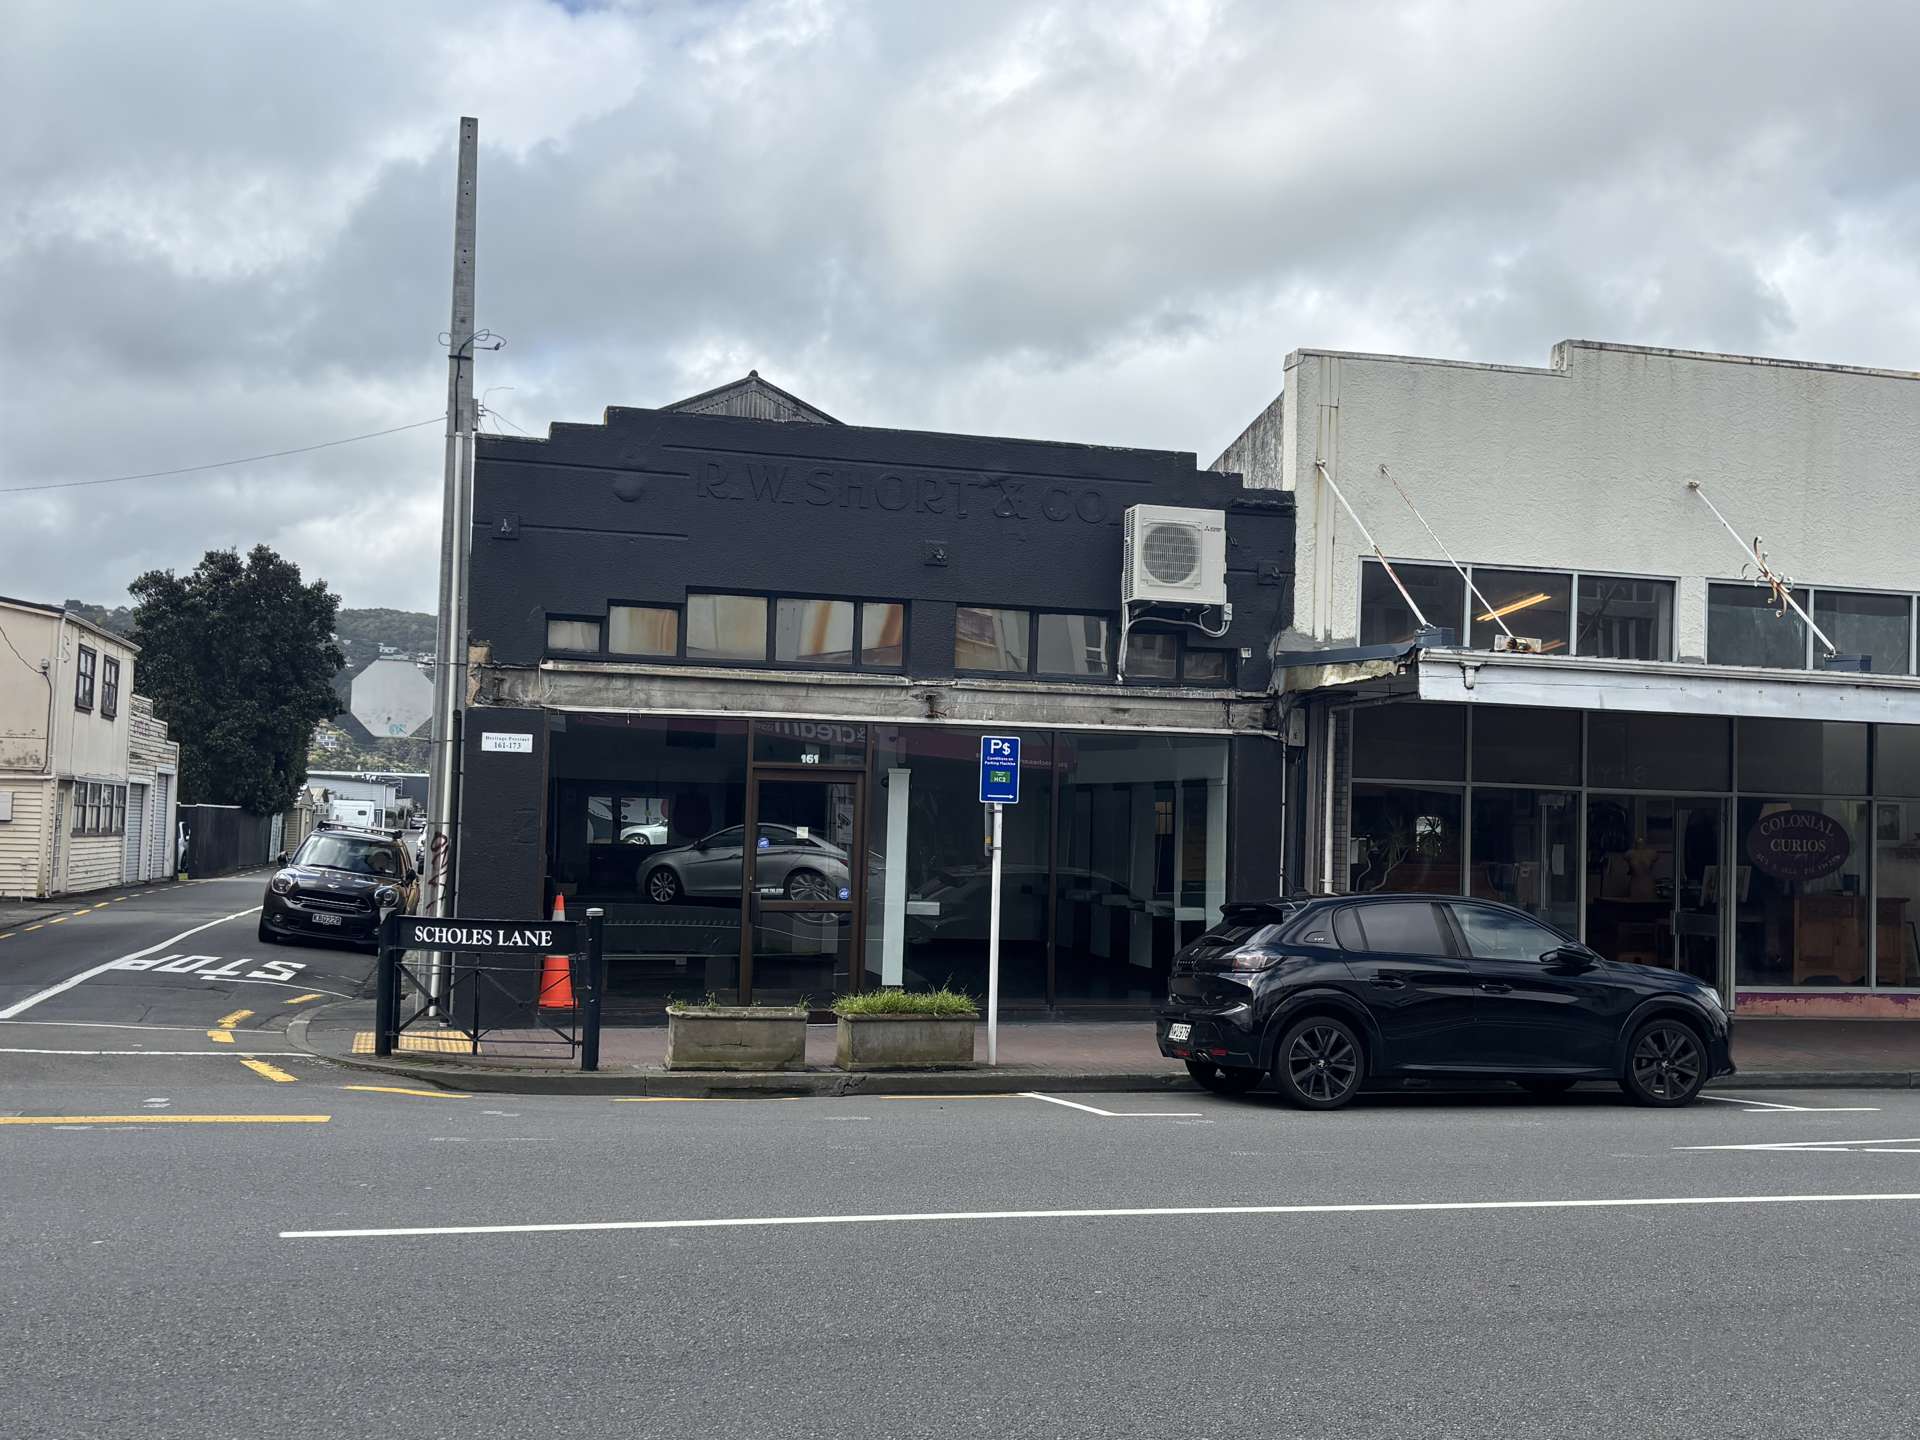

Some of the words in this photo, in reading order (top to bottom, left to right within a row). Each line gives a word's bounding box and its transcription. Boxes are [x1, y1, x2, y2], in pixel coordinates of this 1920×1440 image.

[806, 471, 970, 518] SHORT
[992, 483, 1028, 520] &
[494, 741, 521, 750] 161-173
[990, 739, 1011, 755] P$
[800, 754, 819, 764] 161
[1760, 815, 1835, 837] COLONIAL
[1770, 838, 1827, 852] CURIOS
[414, 925, 492, 946] SCHOLES
[497, 930, 553, 947] LANE
[110, 954, 307, 981] STOP
